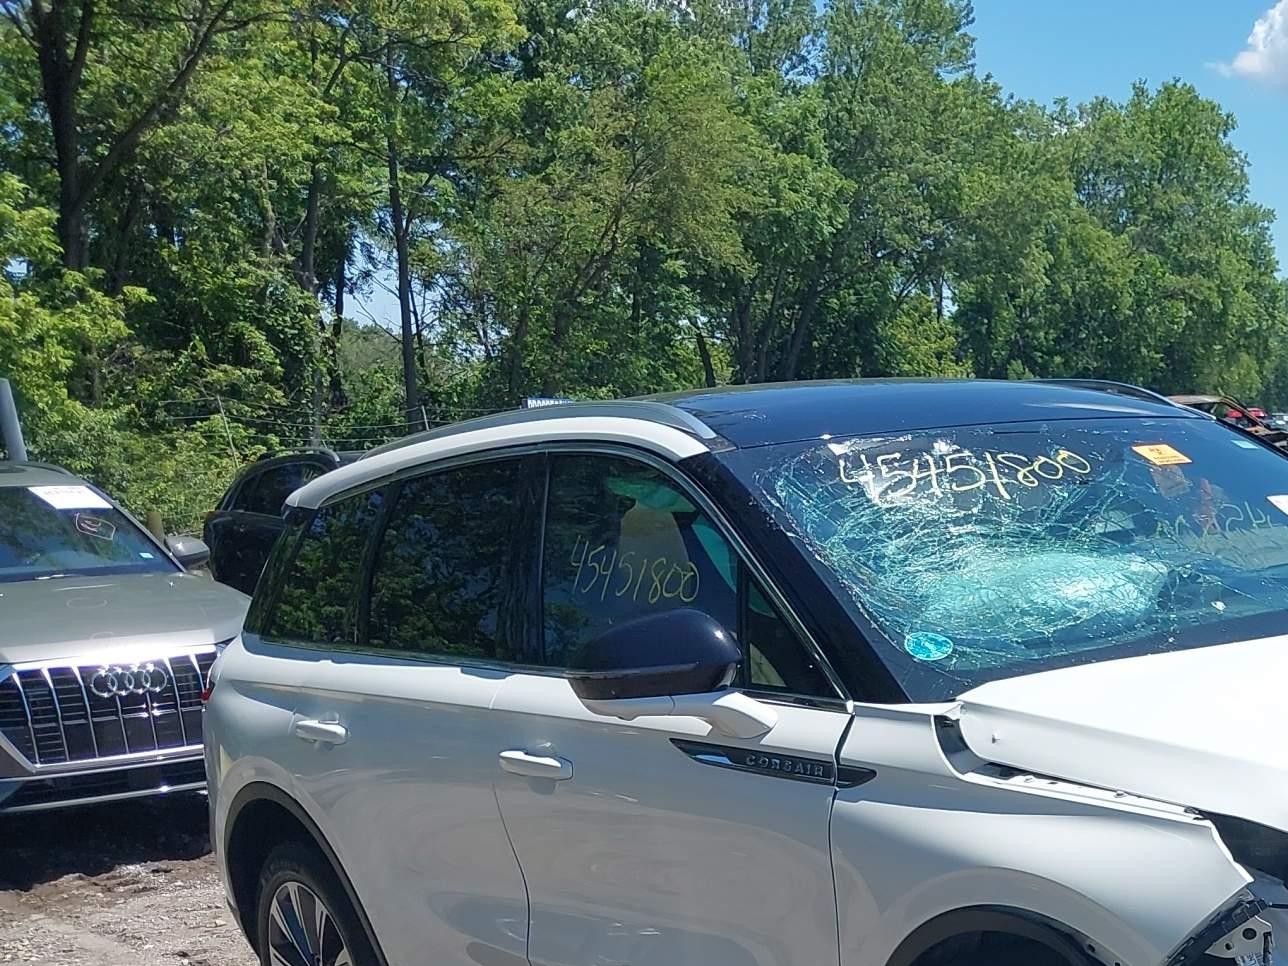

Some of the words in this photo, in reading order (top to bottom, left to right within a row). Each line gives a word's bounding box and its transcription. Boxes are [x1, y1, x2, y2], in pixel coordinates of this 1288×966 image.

[838, 449, 1091, 503] 45451800
[570, 534, 700, 604] 45451800
[746, 755, 824, 777] CORSAIR
